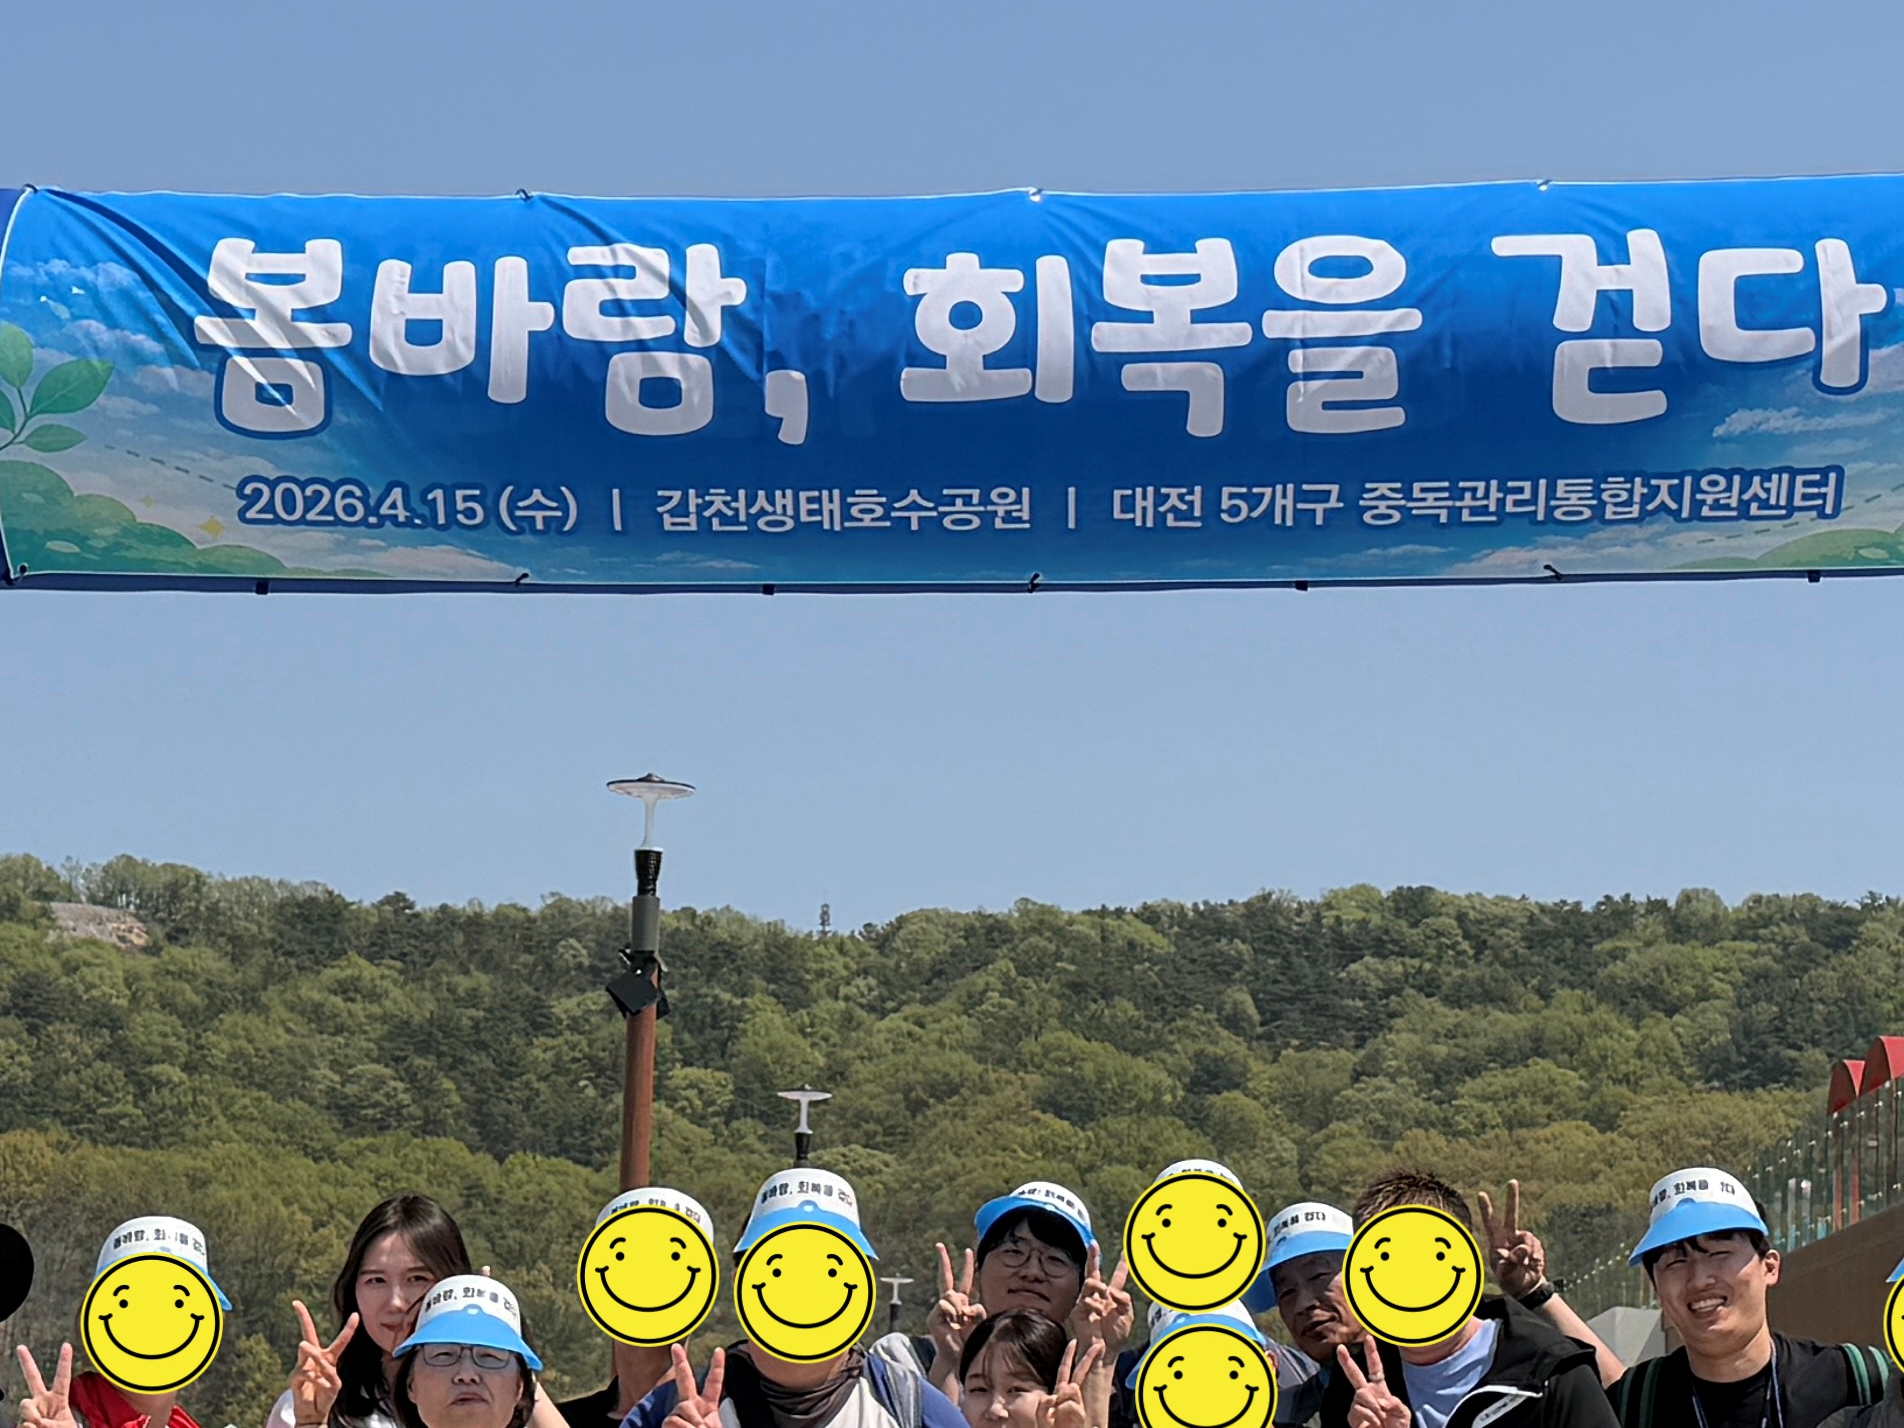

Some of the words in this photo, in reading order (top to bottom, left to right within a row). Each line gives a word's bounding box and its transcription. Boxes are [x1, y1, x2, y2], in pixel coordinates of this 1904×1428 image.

[194, 236, 810, 446] 봄바람,
[899, 234, 1423, 438] 회복을
[1490, 227, 1888, 425] 걷다
[242, 480, 486, 527] 2026.4.15
[498, 484, 579, 532] (수)
[655, 486, 1031, 533] 갑천생태호수공원
[1112, 484, 1203, 529] 대전
[1219, 482, 1345, 528] 5개구
[1358, 469, 1838, 526] 중독관리통합지원센터
